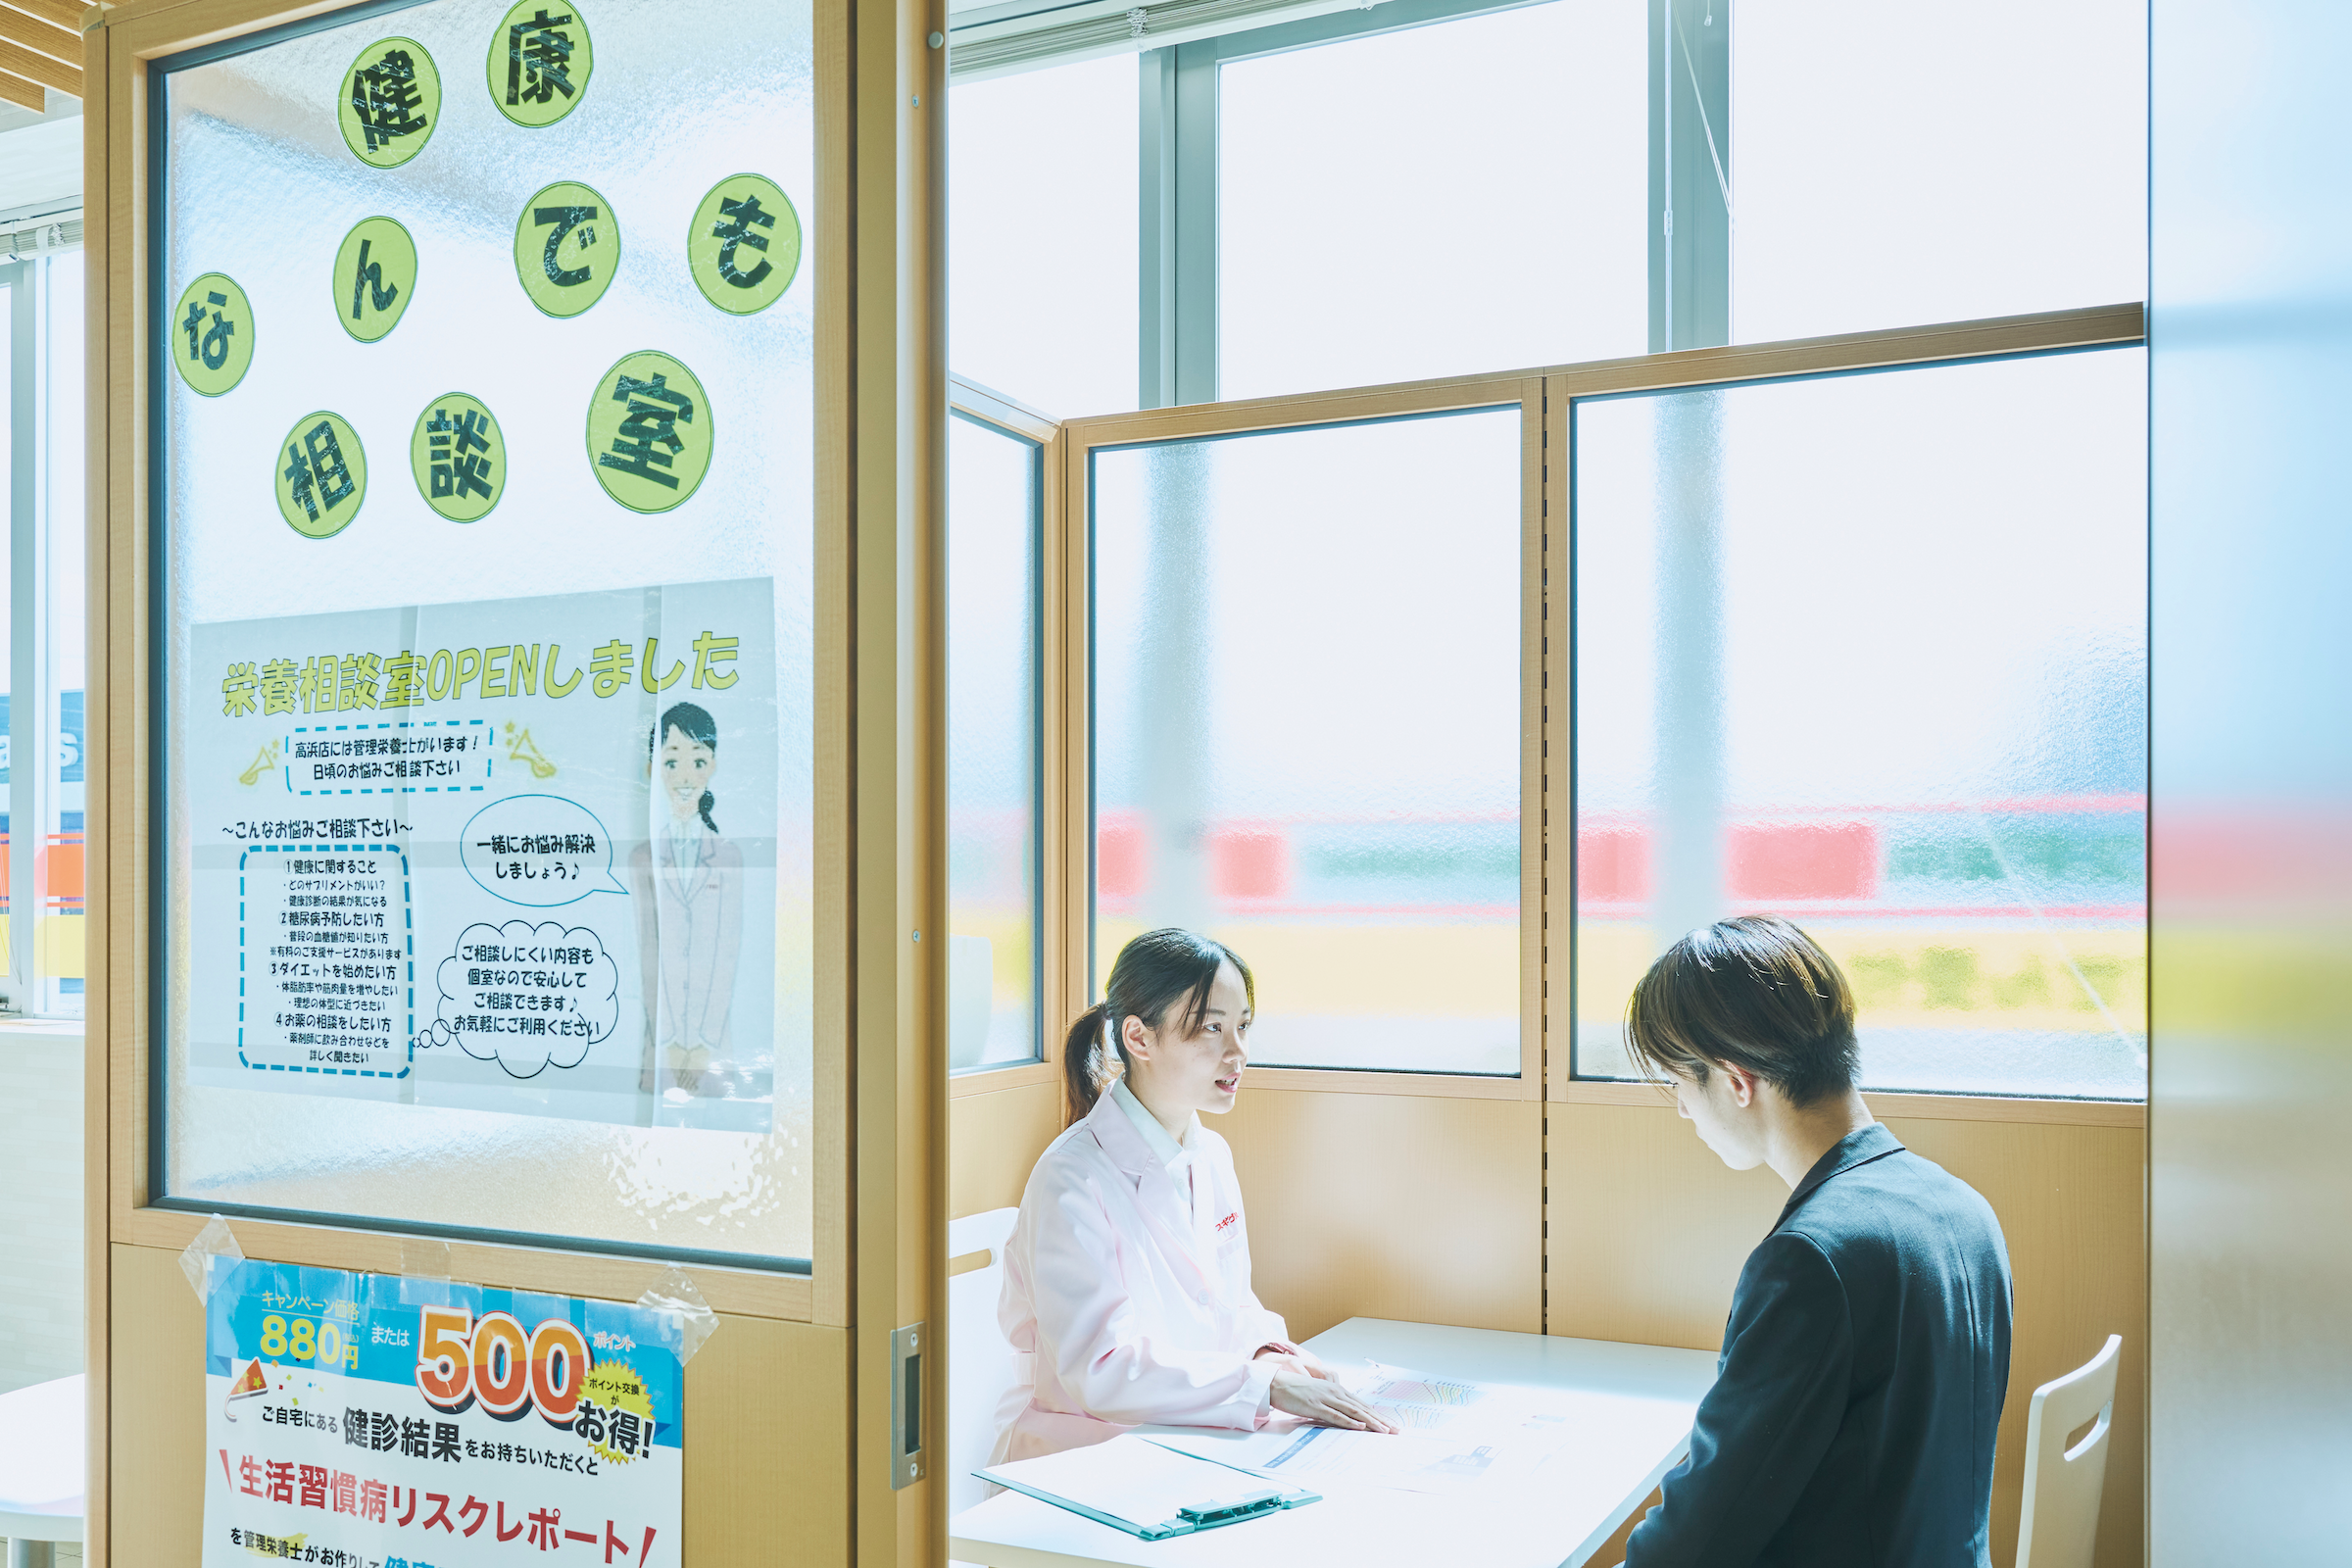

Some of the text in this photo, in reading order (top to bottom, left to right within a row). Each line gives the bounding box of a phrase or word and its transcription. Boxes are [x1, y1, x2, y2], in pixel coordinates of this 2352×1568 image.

[221, 630, 739, 717] 栄養相談室OPENしました
[314, 760, 461, 780] 日頃のお悩みご相談下さい
[477, 834, 596, 855] 一緒にお悩み解決
[463, 945, 594, 964] ご相談しにくい内容も
[467, 968, 587, 988] 個室なので安心して
[454, 1014, 600, 1037] お気軽にご利用ください
[310, 1050, 369, 1063] 詳しく聞きたい
[262, 1290, 360, 1321] キャンペーン価格
[371, 1323, 410, 1347] または
[593, 1331, 636, 1351] ポイント
[415, 1303, 594, 1428] 500
[589, 1378, 640, 1396] ポイント交換
